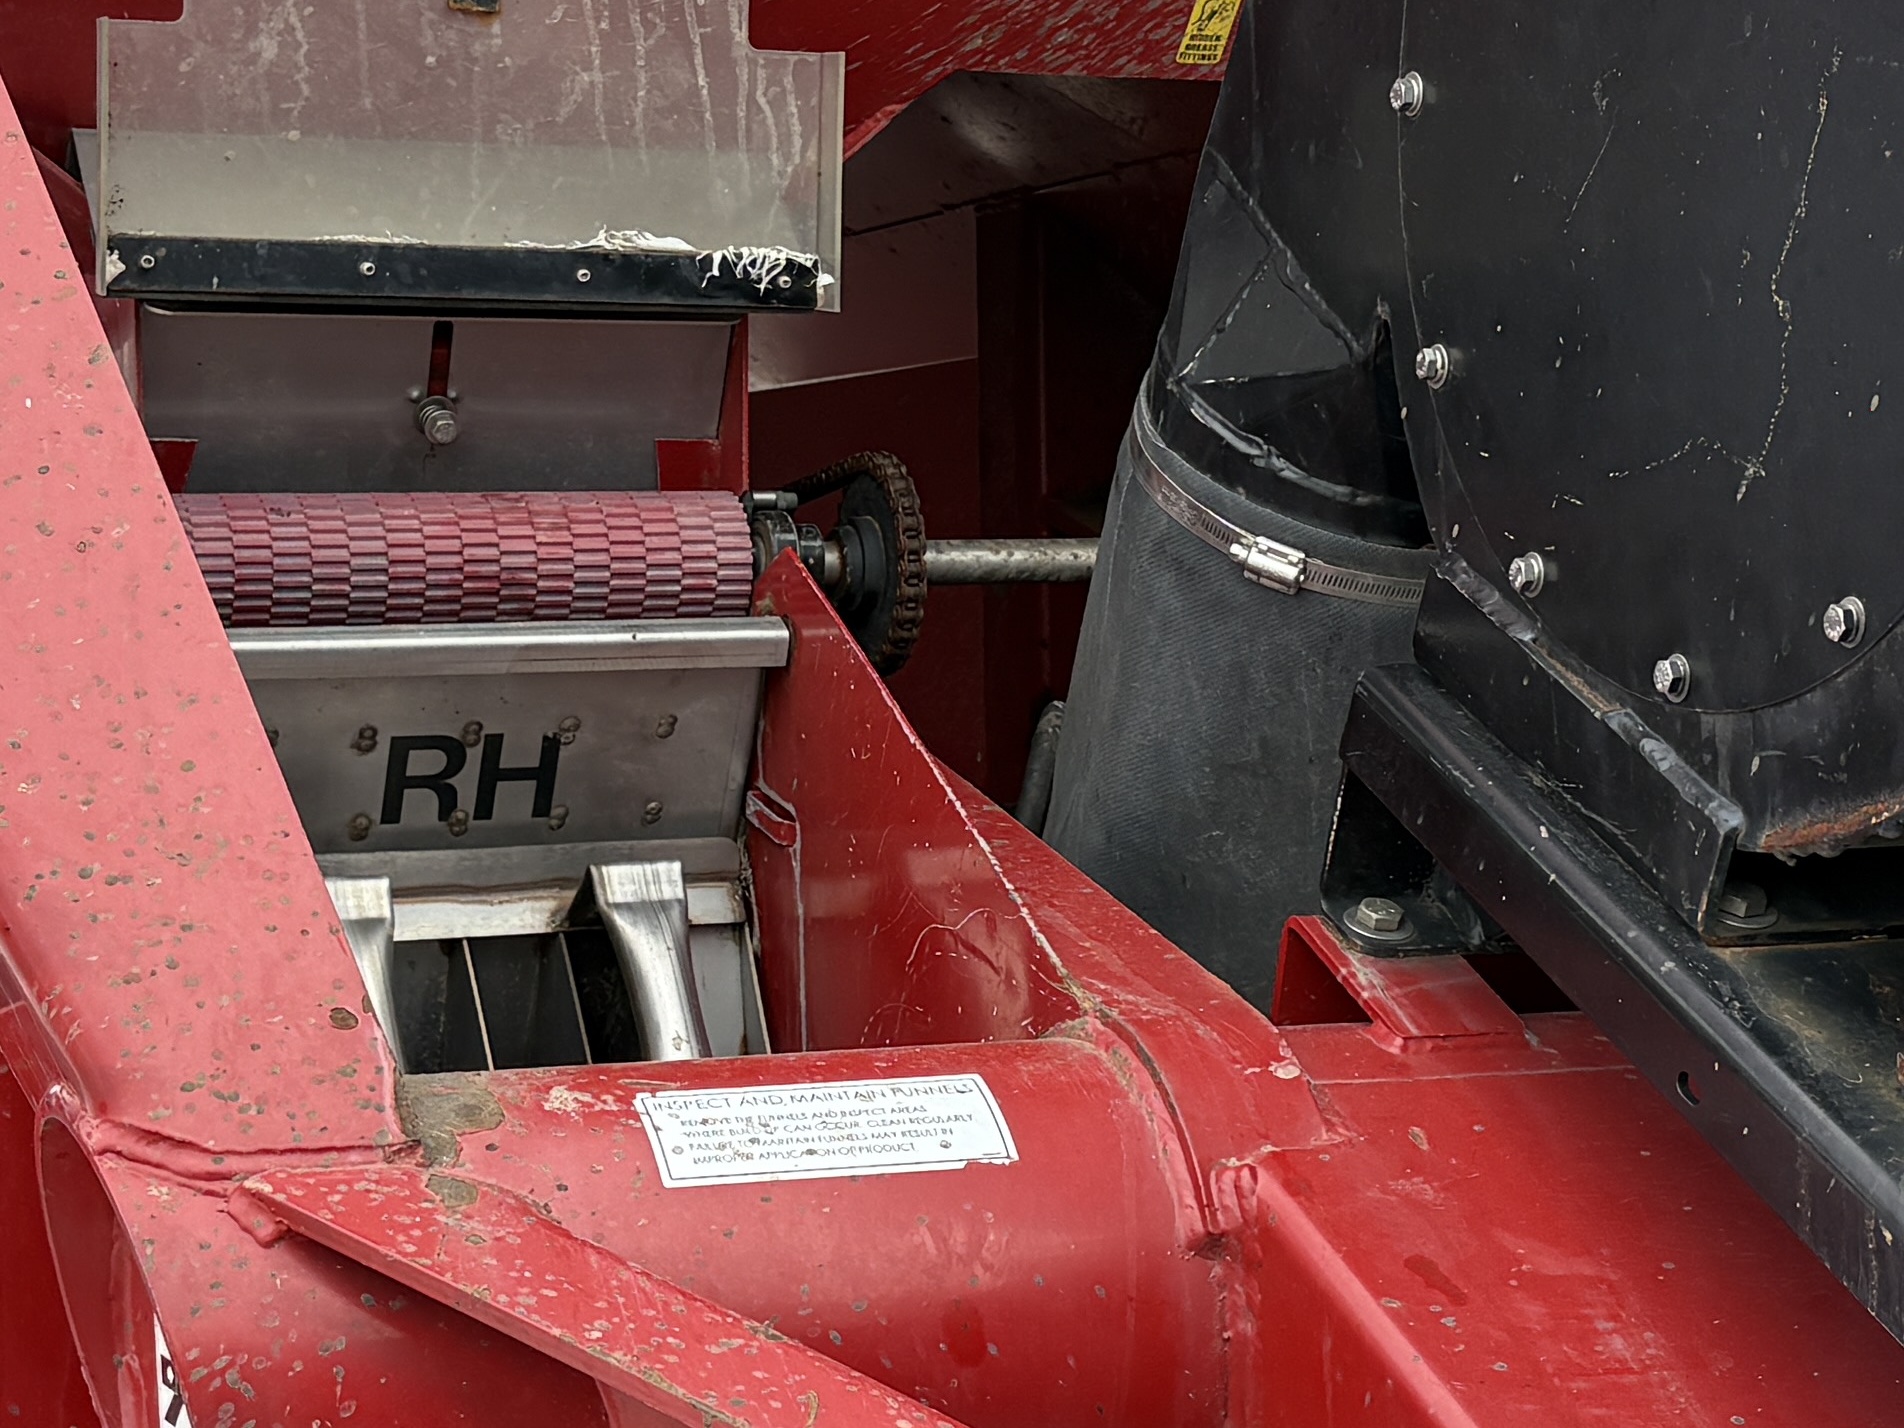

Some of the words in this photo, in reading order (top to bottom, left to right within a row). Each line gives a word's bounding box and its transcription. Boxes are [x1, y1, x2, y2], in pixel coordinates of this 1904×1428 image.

[1178, 51, 1218, 61] FITTINGS
[379, 732, 561, 825] RH
[653, 1097, 731, 1111] INSPECT
[739, 1095, 783, 1107] AND
[790, 1089, 887, 1104] MAINTAIN
[890, 1084, 974, 1098] FUNNELS
